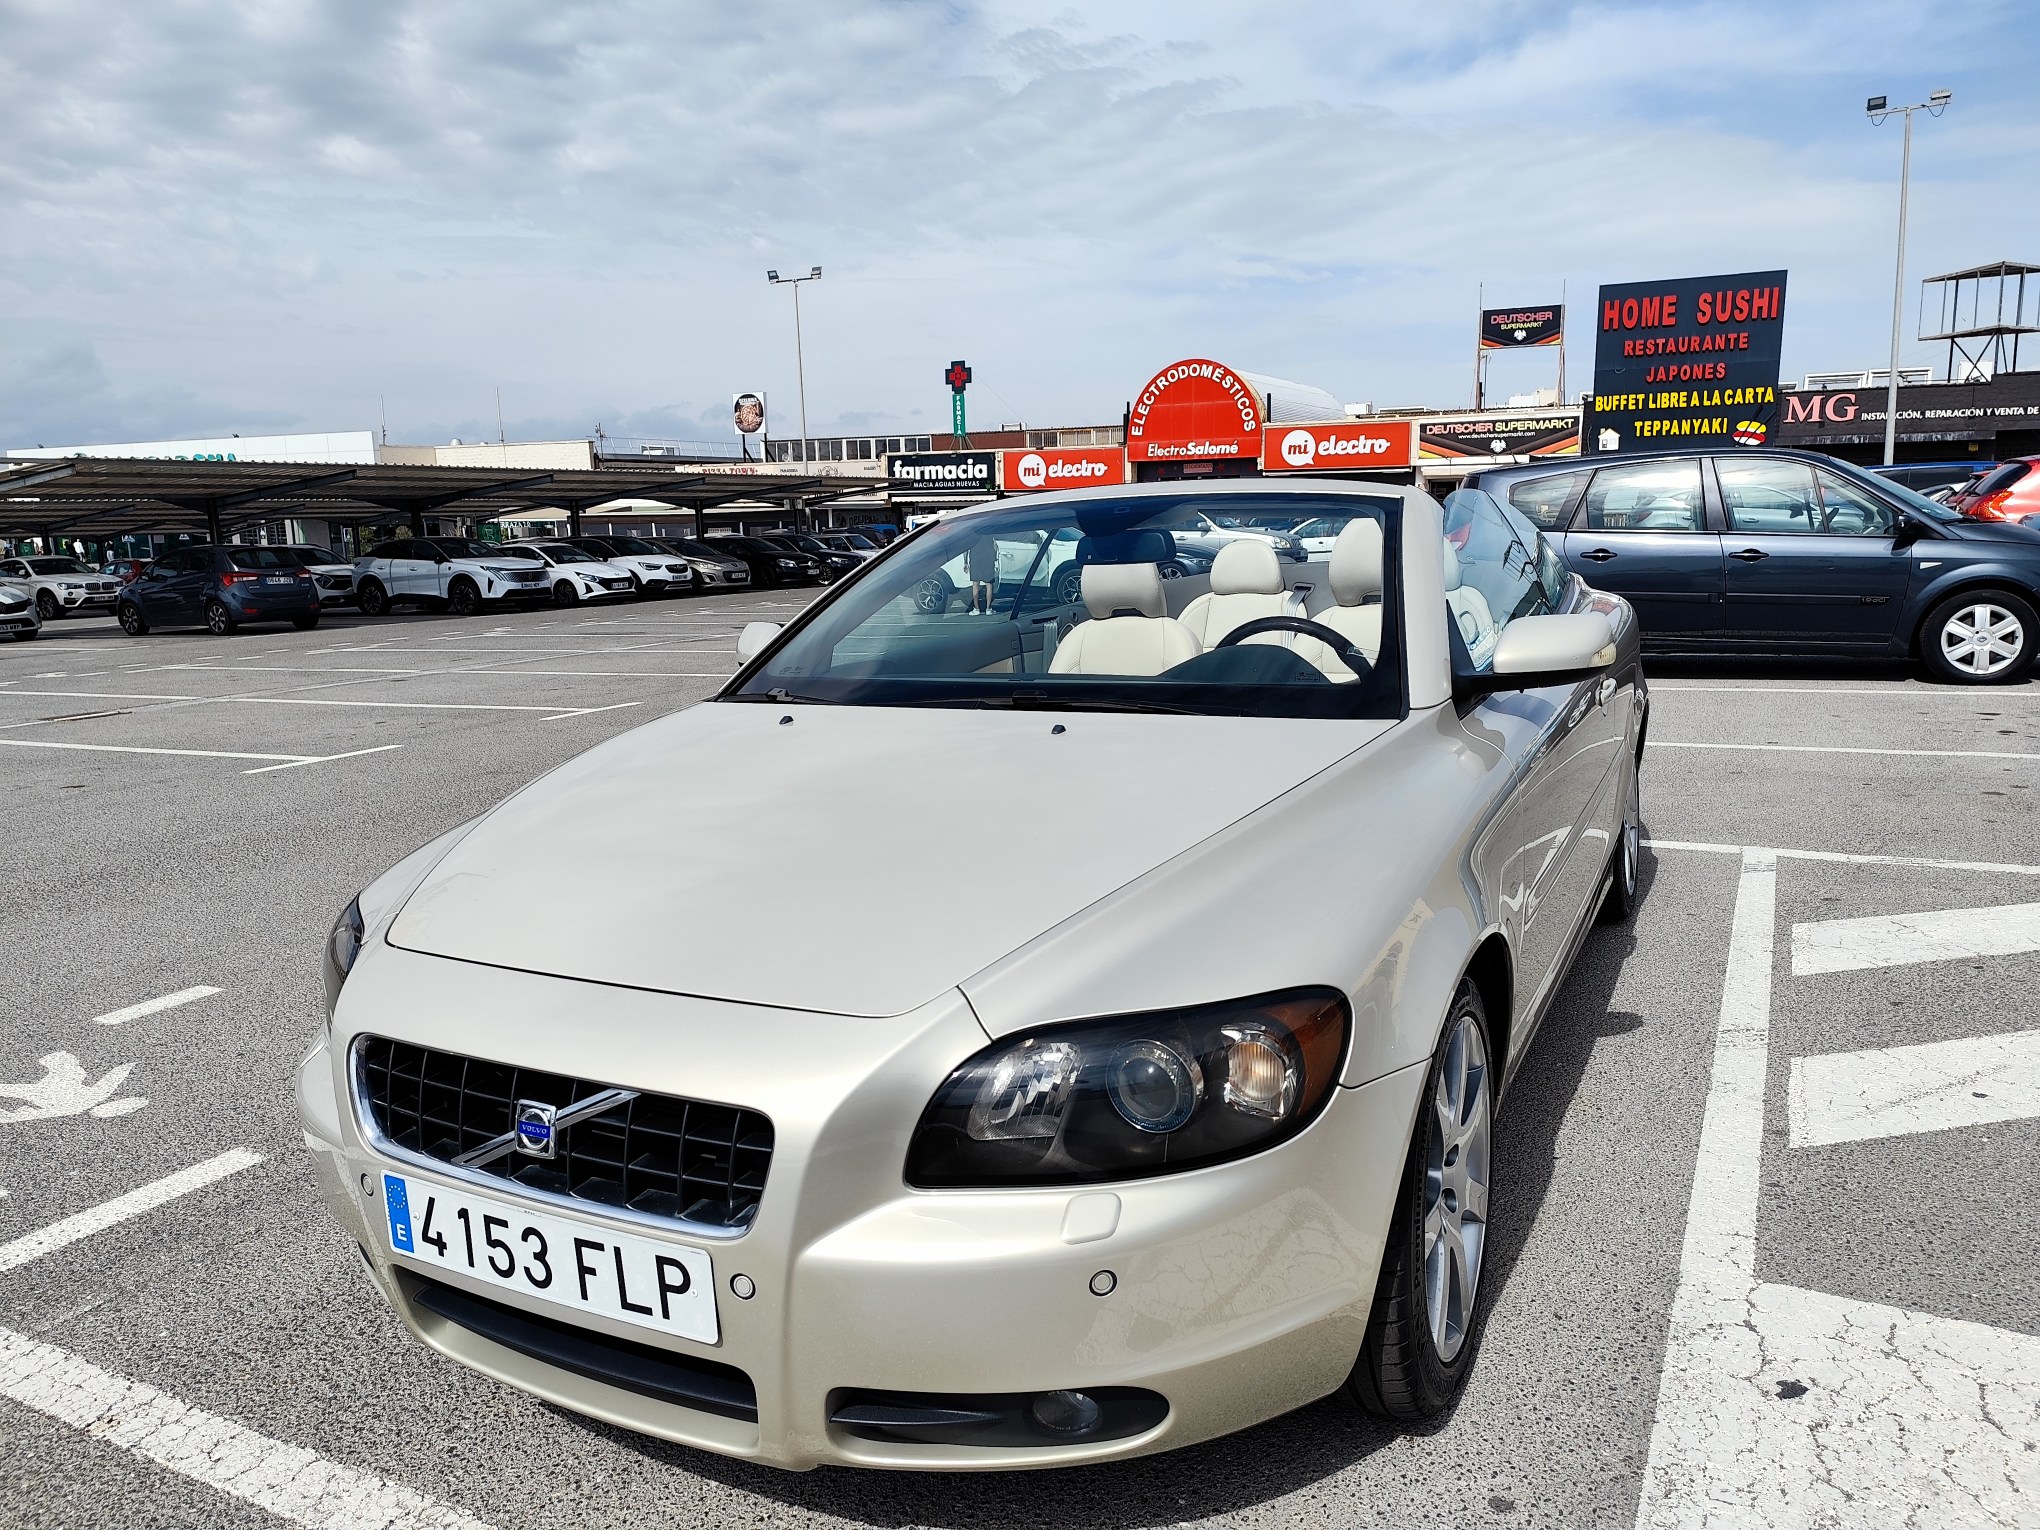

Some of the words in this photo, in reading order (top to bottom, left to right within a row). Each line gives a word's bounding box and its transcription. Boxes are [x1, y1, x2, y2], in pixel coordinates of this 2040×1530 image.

[1490, 311, 1553, 324] DEUTSCHER
[1603, 295, 1678, 330] HOME
[1697, 286, 1780, 325] SUSHI
[1500, 321, 1543, 330] SUPERMARKT
[1623, 332, 1749, 357] RESTAURANTE
[1645, 362, 1727, 383] JAPONES
[1131, 363, 1256, 436] ELECTRODOMÉSTICOS
[1594, 393, 1645, 412] BUFFET
[1648, 391, 1687, 409] LIBRE
[1690, 390, 1701, 407] A
[1703, 389, 1722, 406] LA
[1724, 386, 1775, 405] CARTA
[1783, 392, 1860, 423] MG
[1925, 406, 1984, 418] REPARACIÓN
[1985, 407, 1993, 416] Y
[1994, 406, 2024, 416] VENTA
[2027, 406, 2040, 415] DE
[1426, 422, 1494, 435] DEUTSCHER
[1495, 418, 1575, 432] SUPERMARKT
[1634, 417, 1729, 438] TEPPANYAKI
[1147, 440, 1239, 458] ElectroSalomé
[1287, 440, 1309, 455] mi
[1318, 434, 1391, 456] electro
[893, 458, 988, 480] farmacia
[1023, 463, 1041, 477] mi
[1048, 459, 1108, 478] electro
[521, 1124, 547, 1135] VOLVO
[397, 1223, 408, 1241] E
[422, 1196, 553, 1289] 4153
[573, 1237, 692, 1321] FLP
